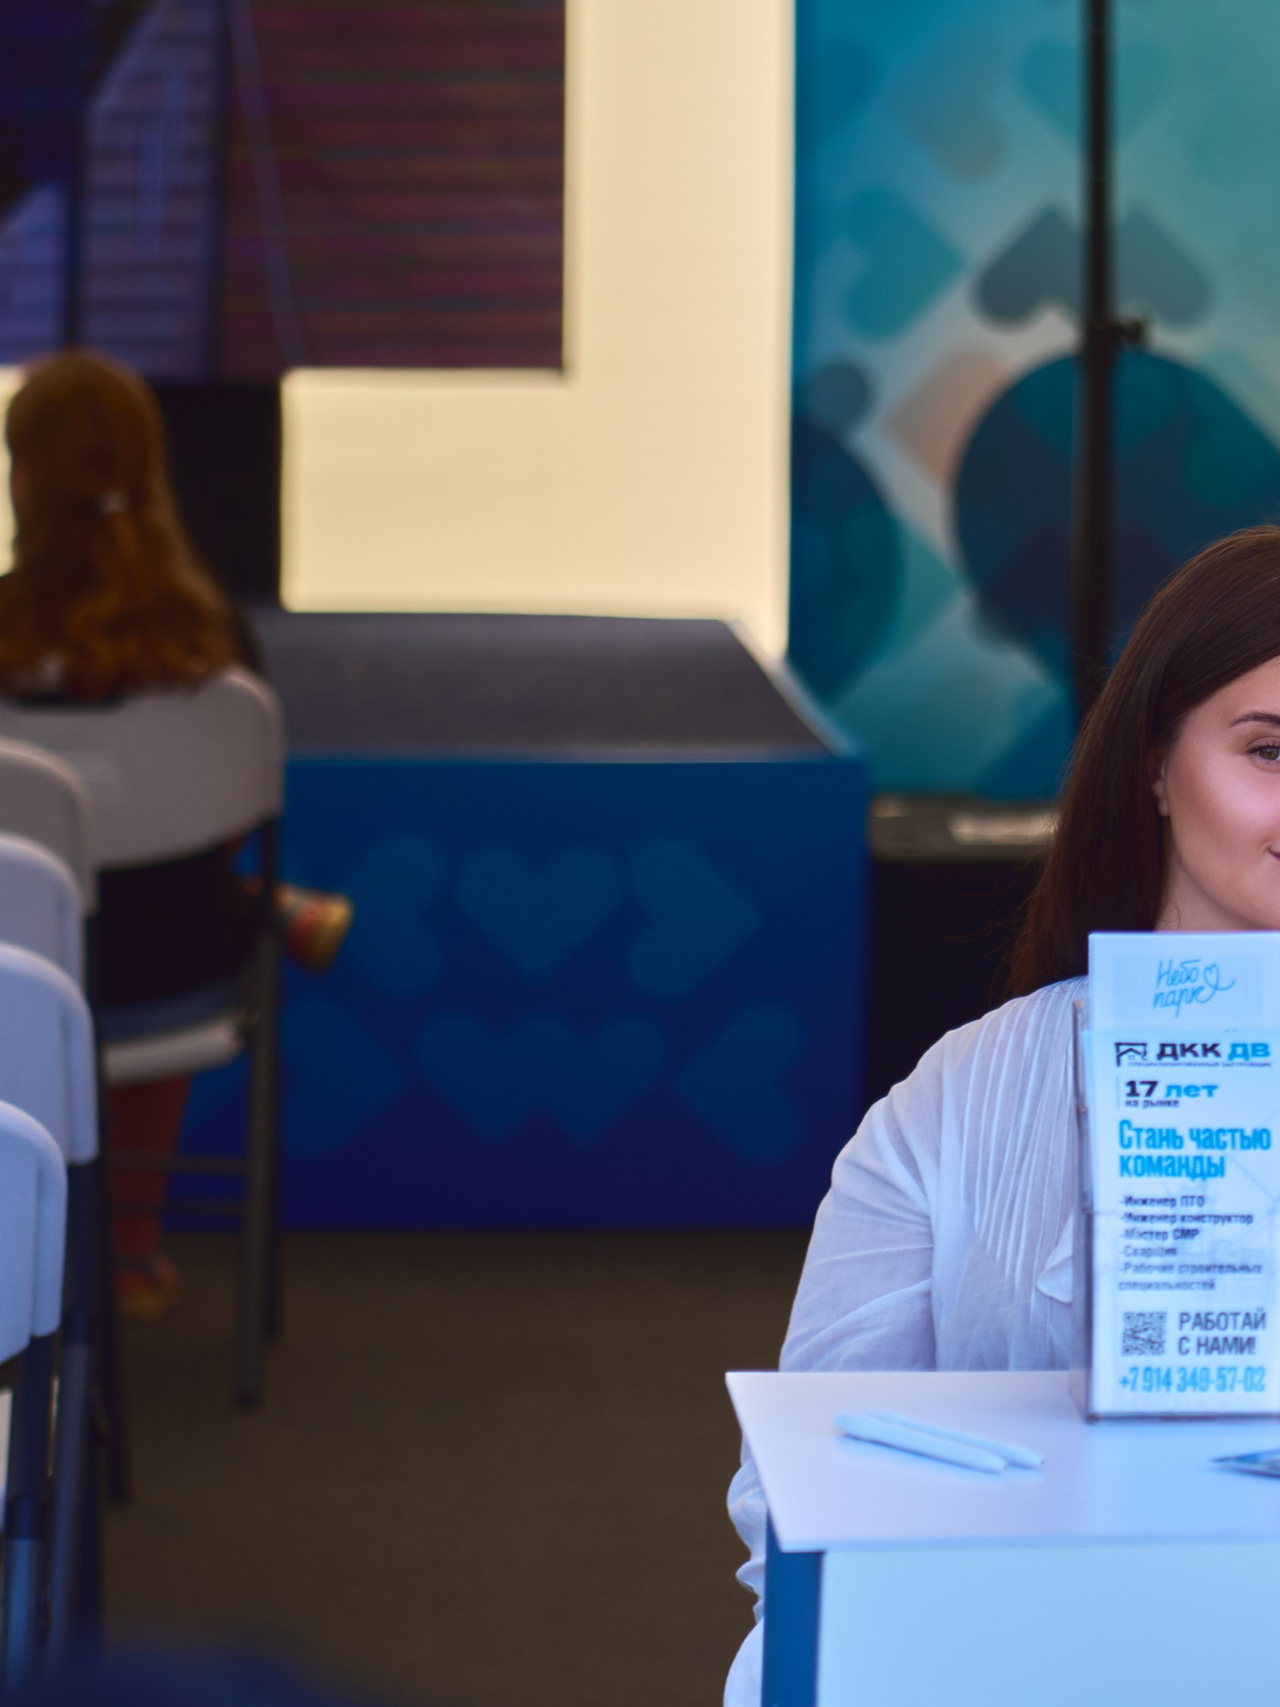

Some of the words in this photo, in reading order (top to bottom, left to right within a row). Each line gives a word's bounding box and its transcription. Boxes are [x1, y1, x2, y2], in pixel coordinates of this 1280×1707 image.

[1155, 958, 1202, 989] Небо
[1152, 985, 1210, 1019] парк
[1156, 1043, 1222, 1061] ДКК
[1227, 1043, 1271, 1061] ДВ
[1125, 1080, 1159, 1098] 17
[1164, 1084, 1219, 1098] лет
[1125, 1099, 1139, 1108] на
[1142, 1099, 1180, 1110] рынке
[1118, 1119, 1184, 1150] Стань
[1188, 1127, 1271, 1150] частью
[1119, 1154, 1225, 1182] команды
[1180, 1195, 1205, 1208] ПТО
[1180, 1214, 1253, 1226] конструктор
[1172, 1228, 1200, 1241] СМР
[1178, 1264, 1262, 1276] строительных
[1118, 1279, 1216, 1292] специальностей
[1178, 1308, 1267, 1331] РАБОТАЙ
[1178, 1336, 1190, 1356] С
[1196, 1336, 1256, 1356] НАМИ!
[1119, 1366, 1139, 1393] +7
[1142, 1366, 1172, 1393] 914
[1176, 1366, 1266, 1393] 349-57-02
